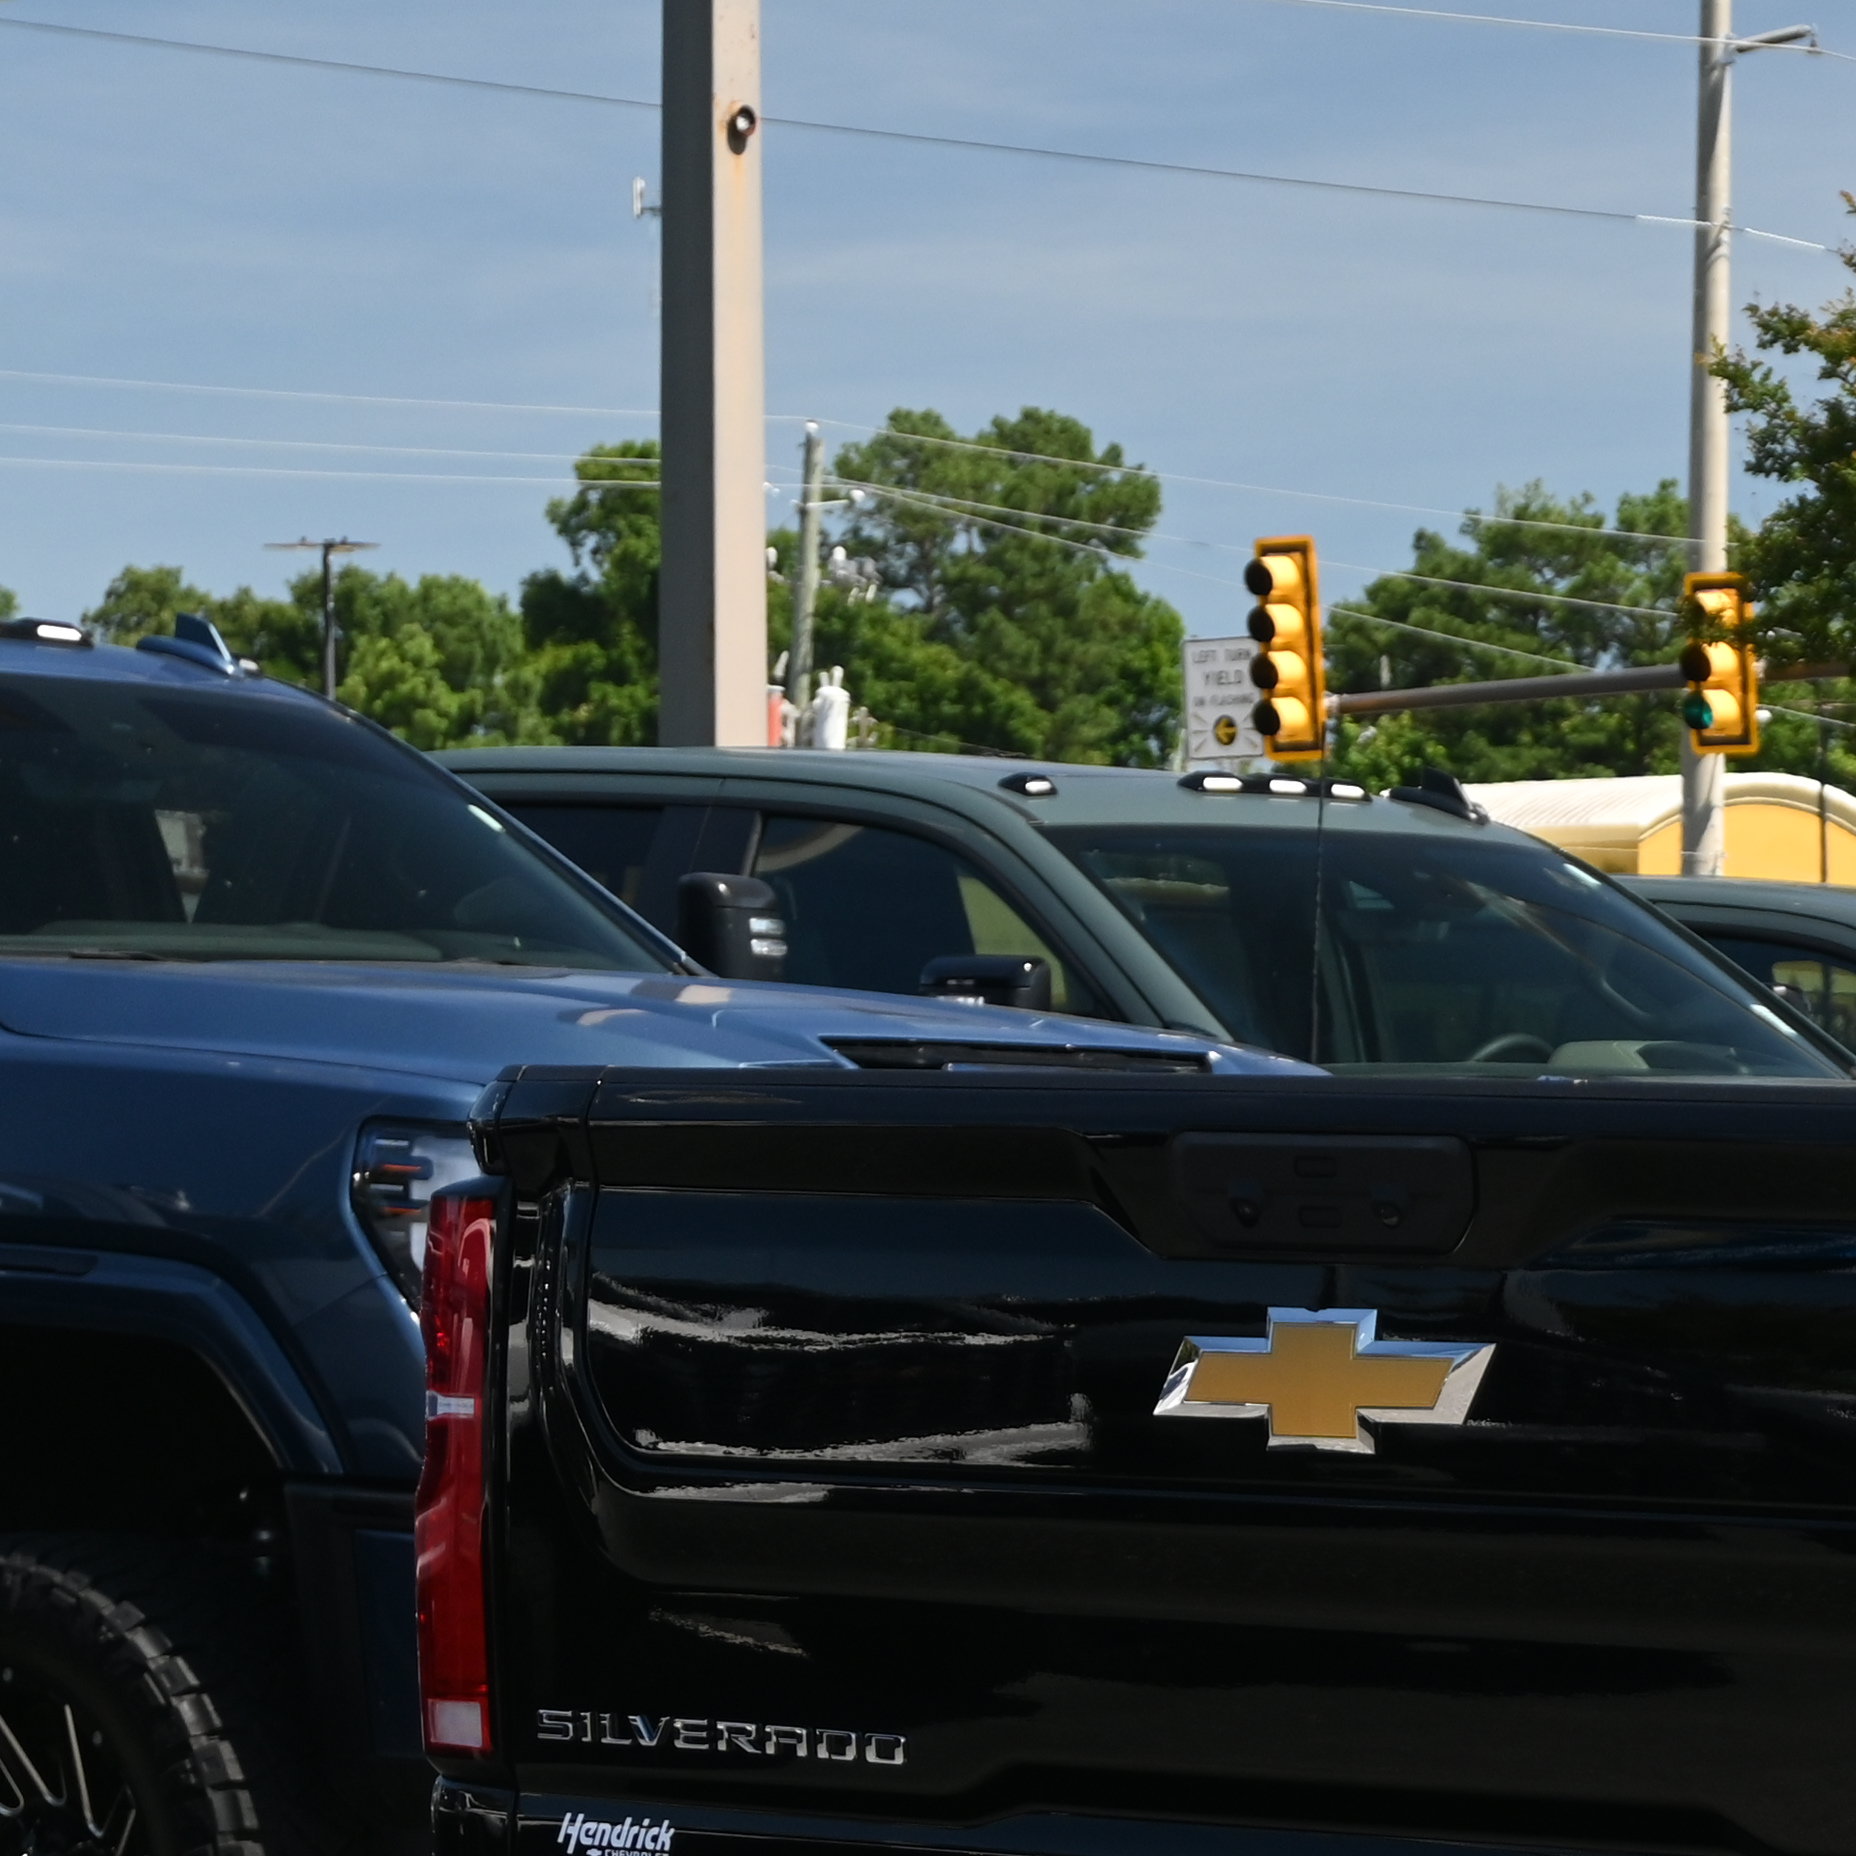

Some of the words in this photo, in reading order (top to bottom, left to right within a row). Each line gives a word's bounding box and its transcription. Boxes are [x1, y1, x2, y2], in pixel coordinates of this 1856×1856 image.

[1191, 649, 1217, 664] LEFT
[1225, 647, 1252, 662] TURN
[1203, 669, 1244, 686] YIELD
[536, 1708, 908, 1766] SILVERADO
[556, 1811, 675, 1855] Hendrick
